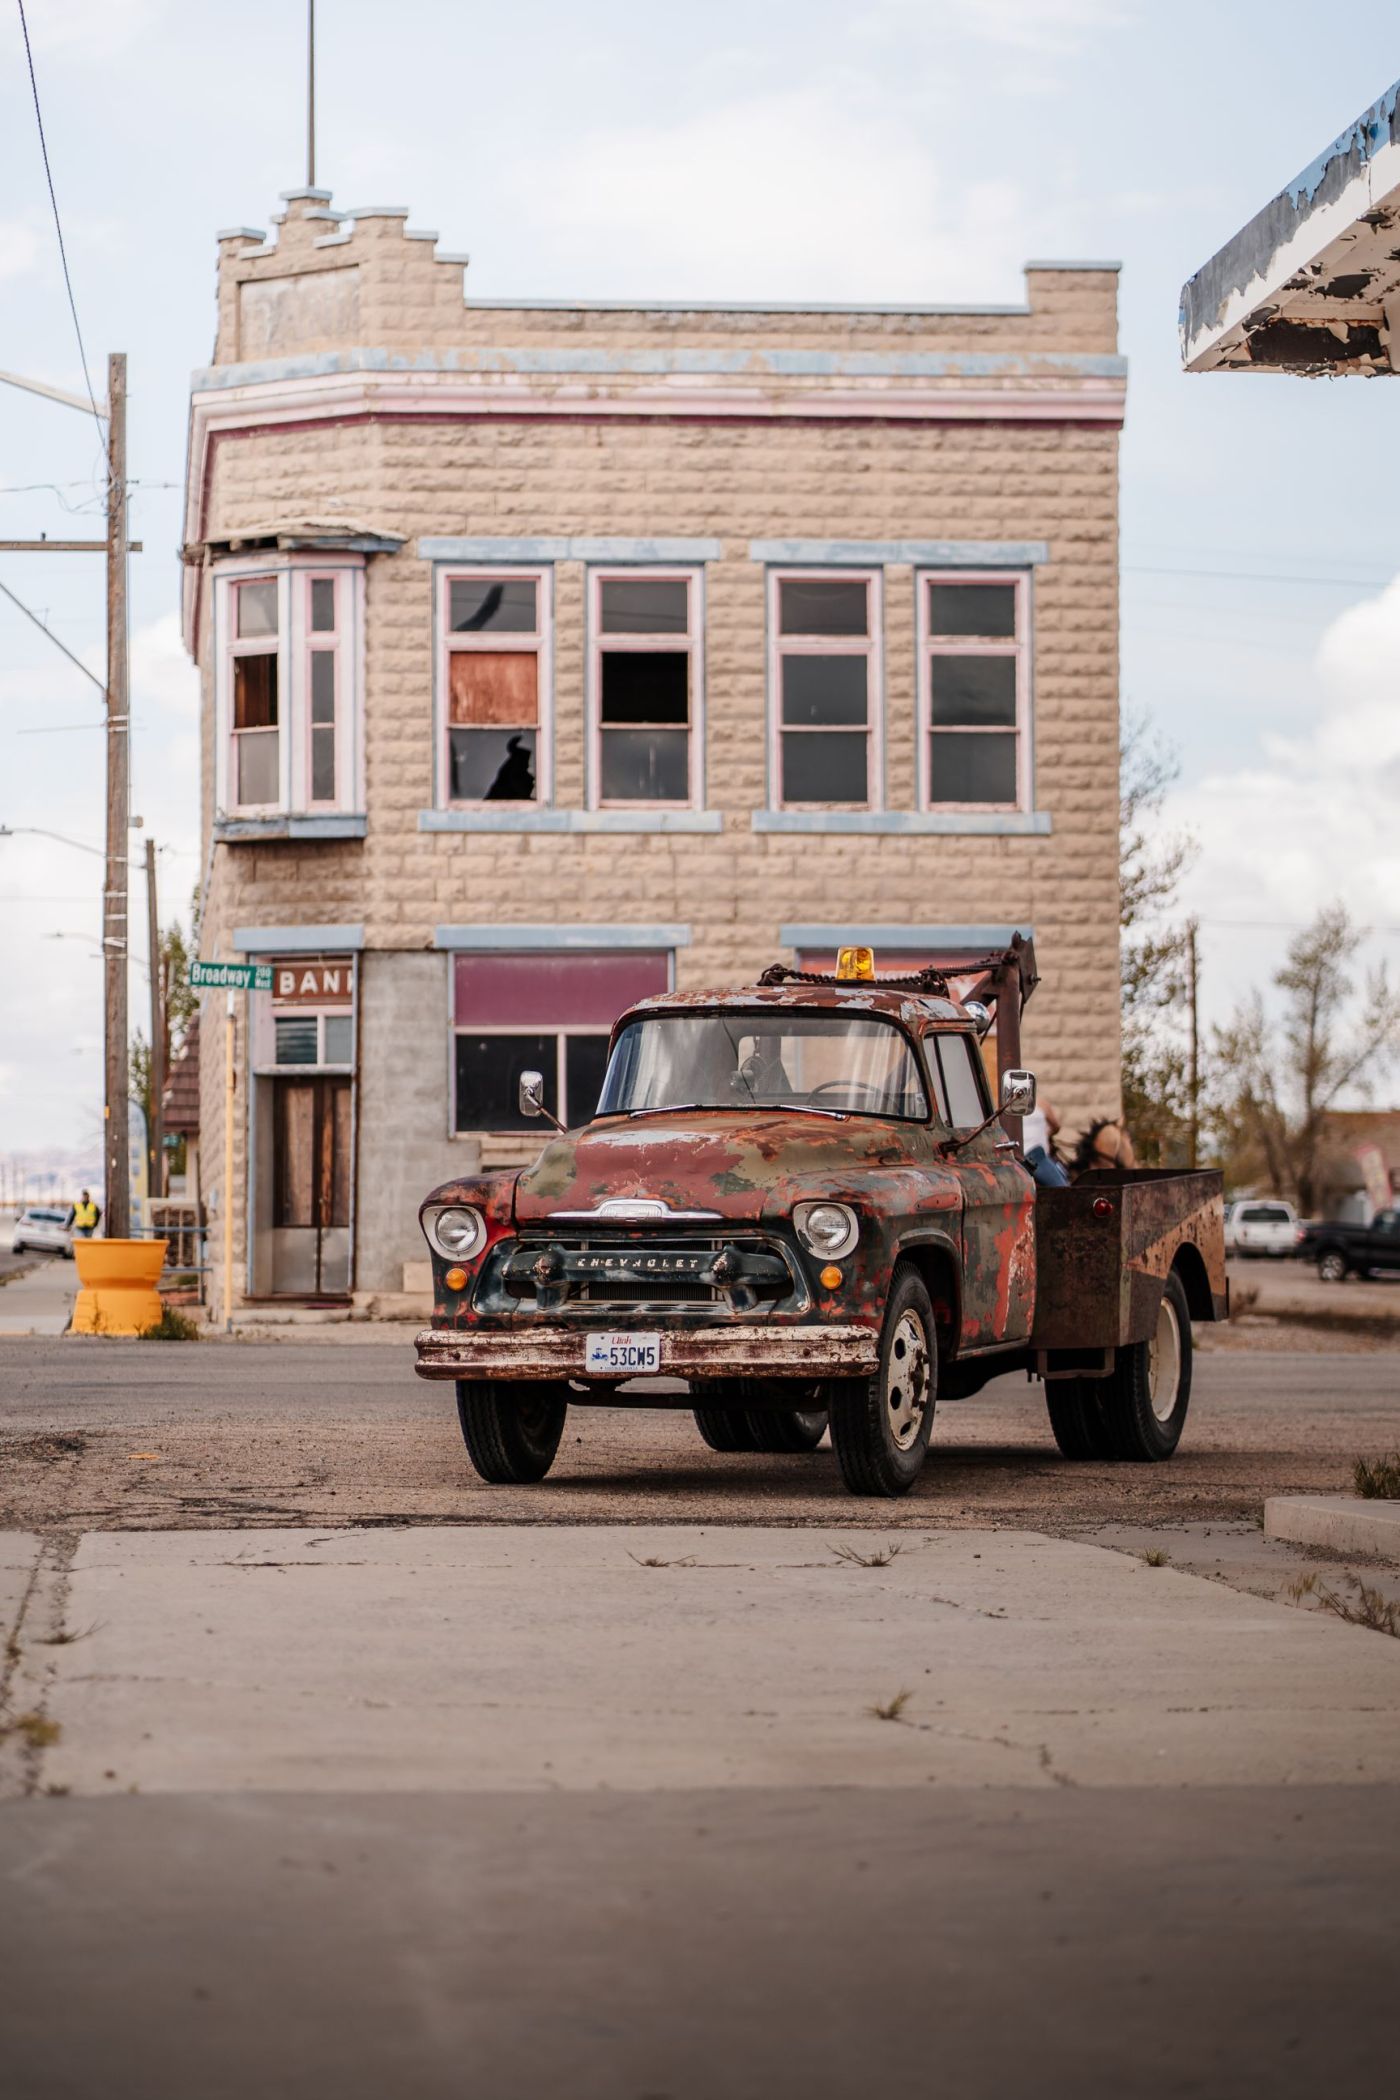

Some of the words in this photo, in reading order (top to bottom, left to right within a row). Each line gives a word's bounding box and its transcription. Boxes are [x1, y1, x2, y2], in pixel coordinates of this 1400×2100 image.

[192, 962, 251, 987] Broadway
[611, 1336, 632, 1345] Utah
[610, 1346, 656, 1366] 53CW5
